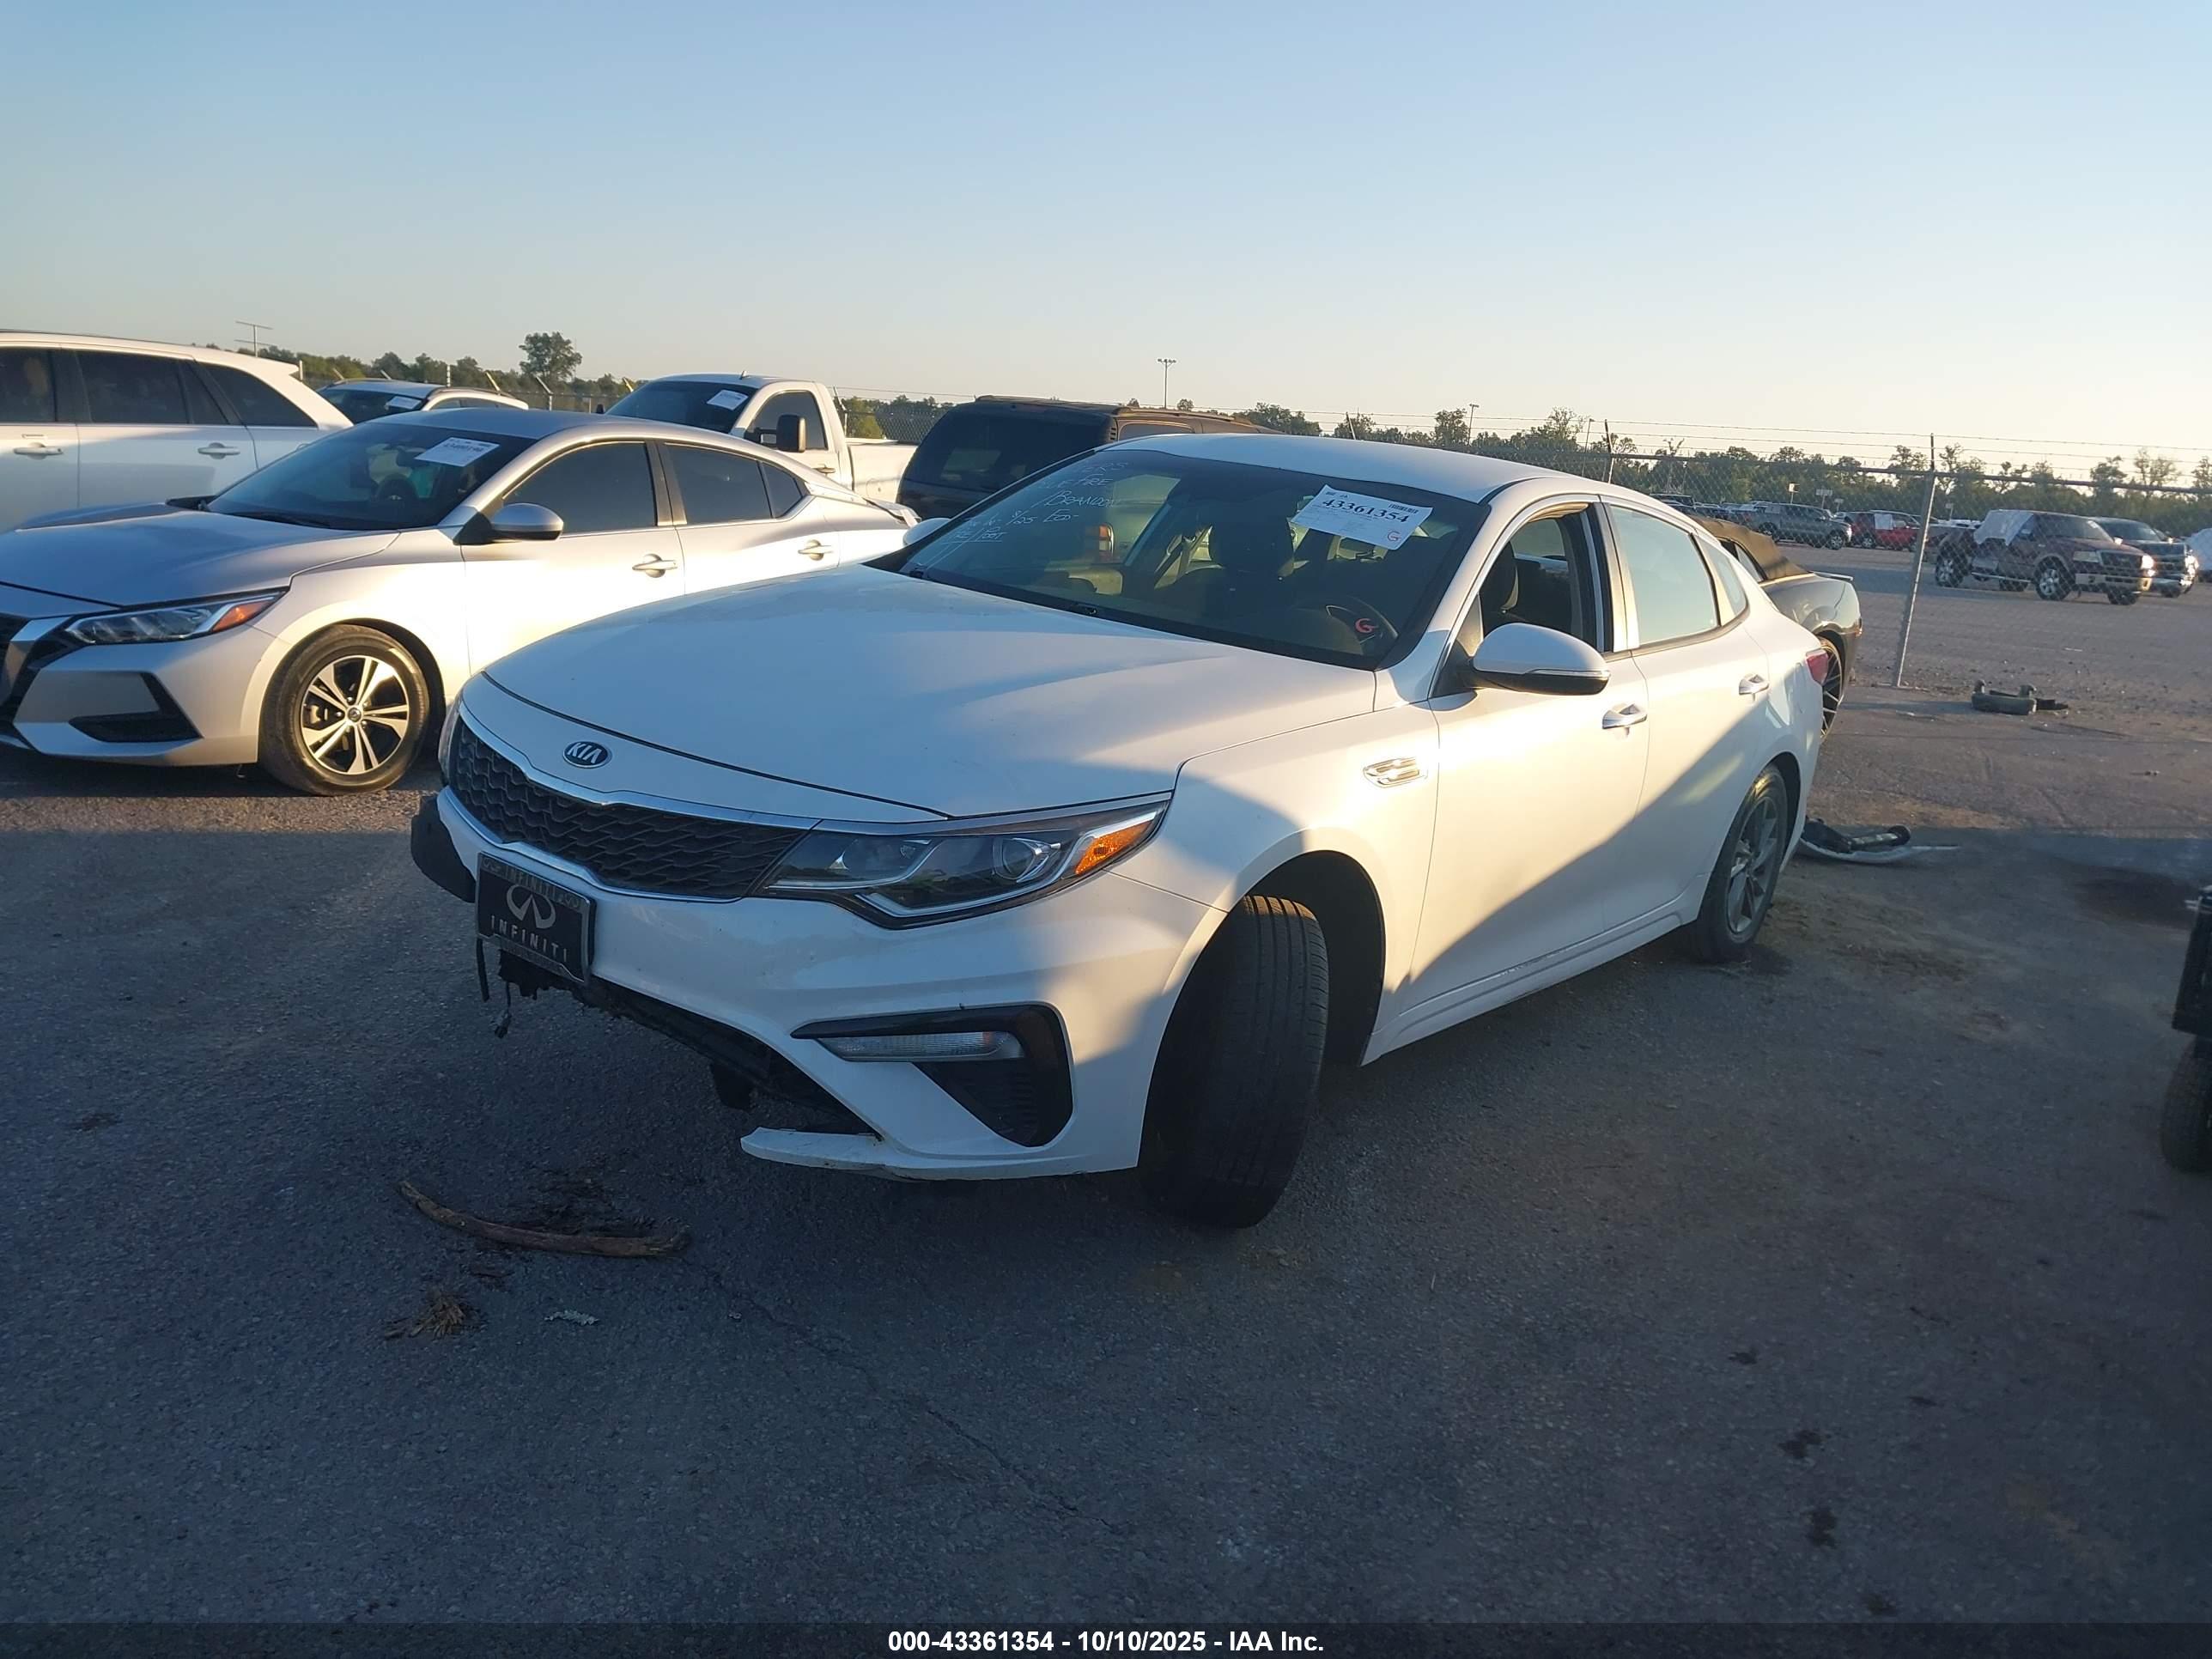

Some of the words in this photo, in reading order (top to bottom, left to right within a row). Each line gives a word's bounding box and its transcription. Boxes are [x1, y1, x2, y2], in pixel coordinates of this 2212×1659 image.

[1322, 498, 1410, 523] 43361354
[567, 742, 603, 764] KIA
[491, 914, 568, 963] INFINITI
